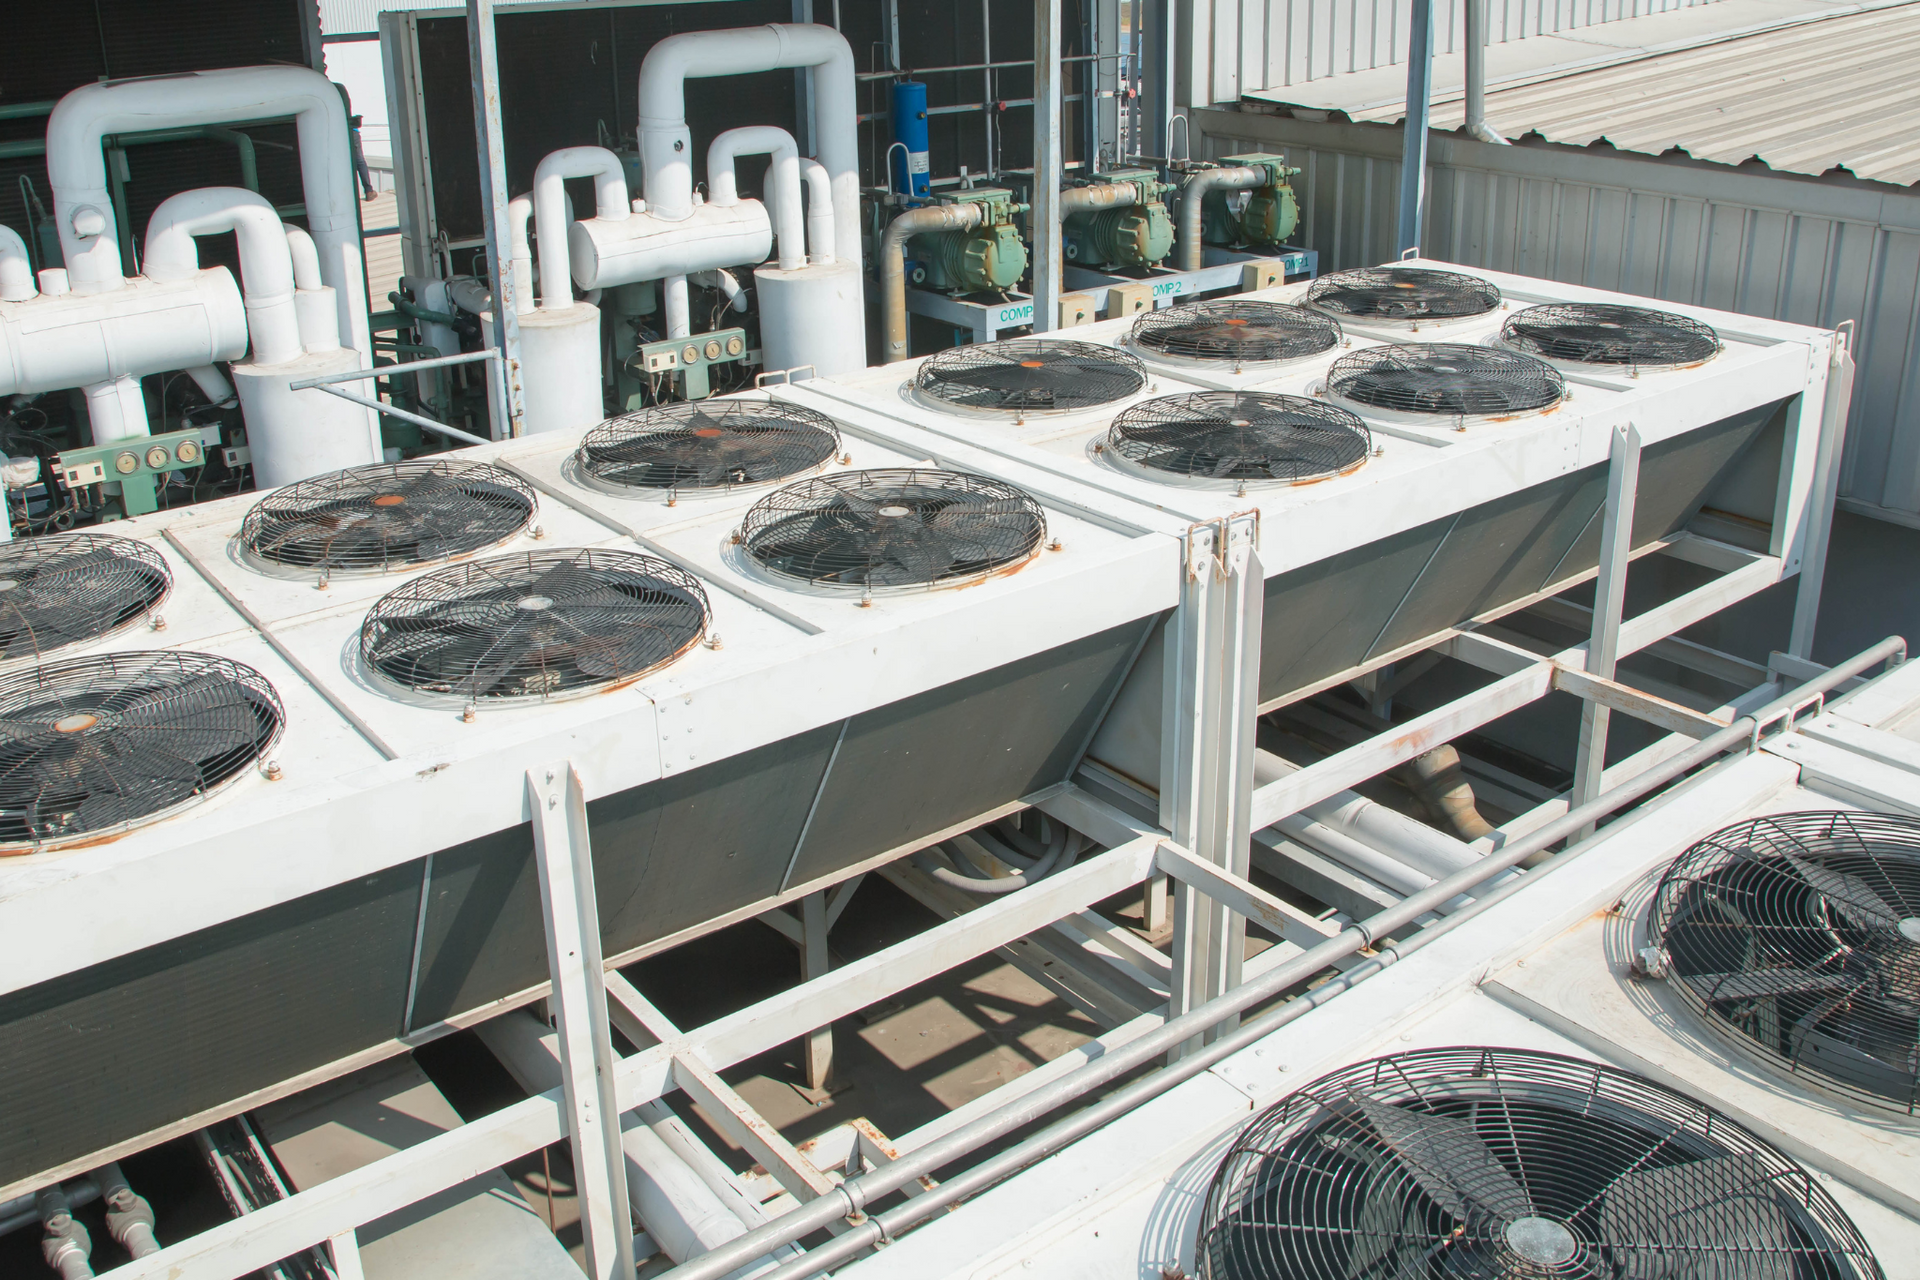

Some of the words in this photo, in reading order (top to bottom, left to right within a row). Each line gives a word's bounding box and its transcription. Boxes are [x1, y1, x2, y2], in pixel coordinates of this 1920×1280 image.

[1283, 256, 1309, 270] OMP.1
[1153, 281, 1182, 297] OMP.2
[1000, 305, 1034, 322] COMP.
